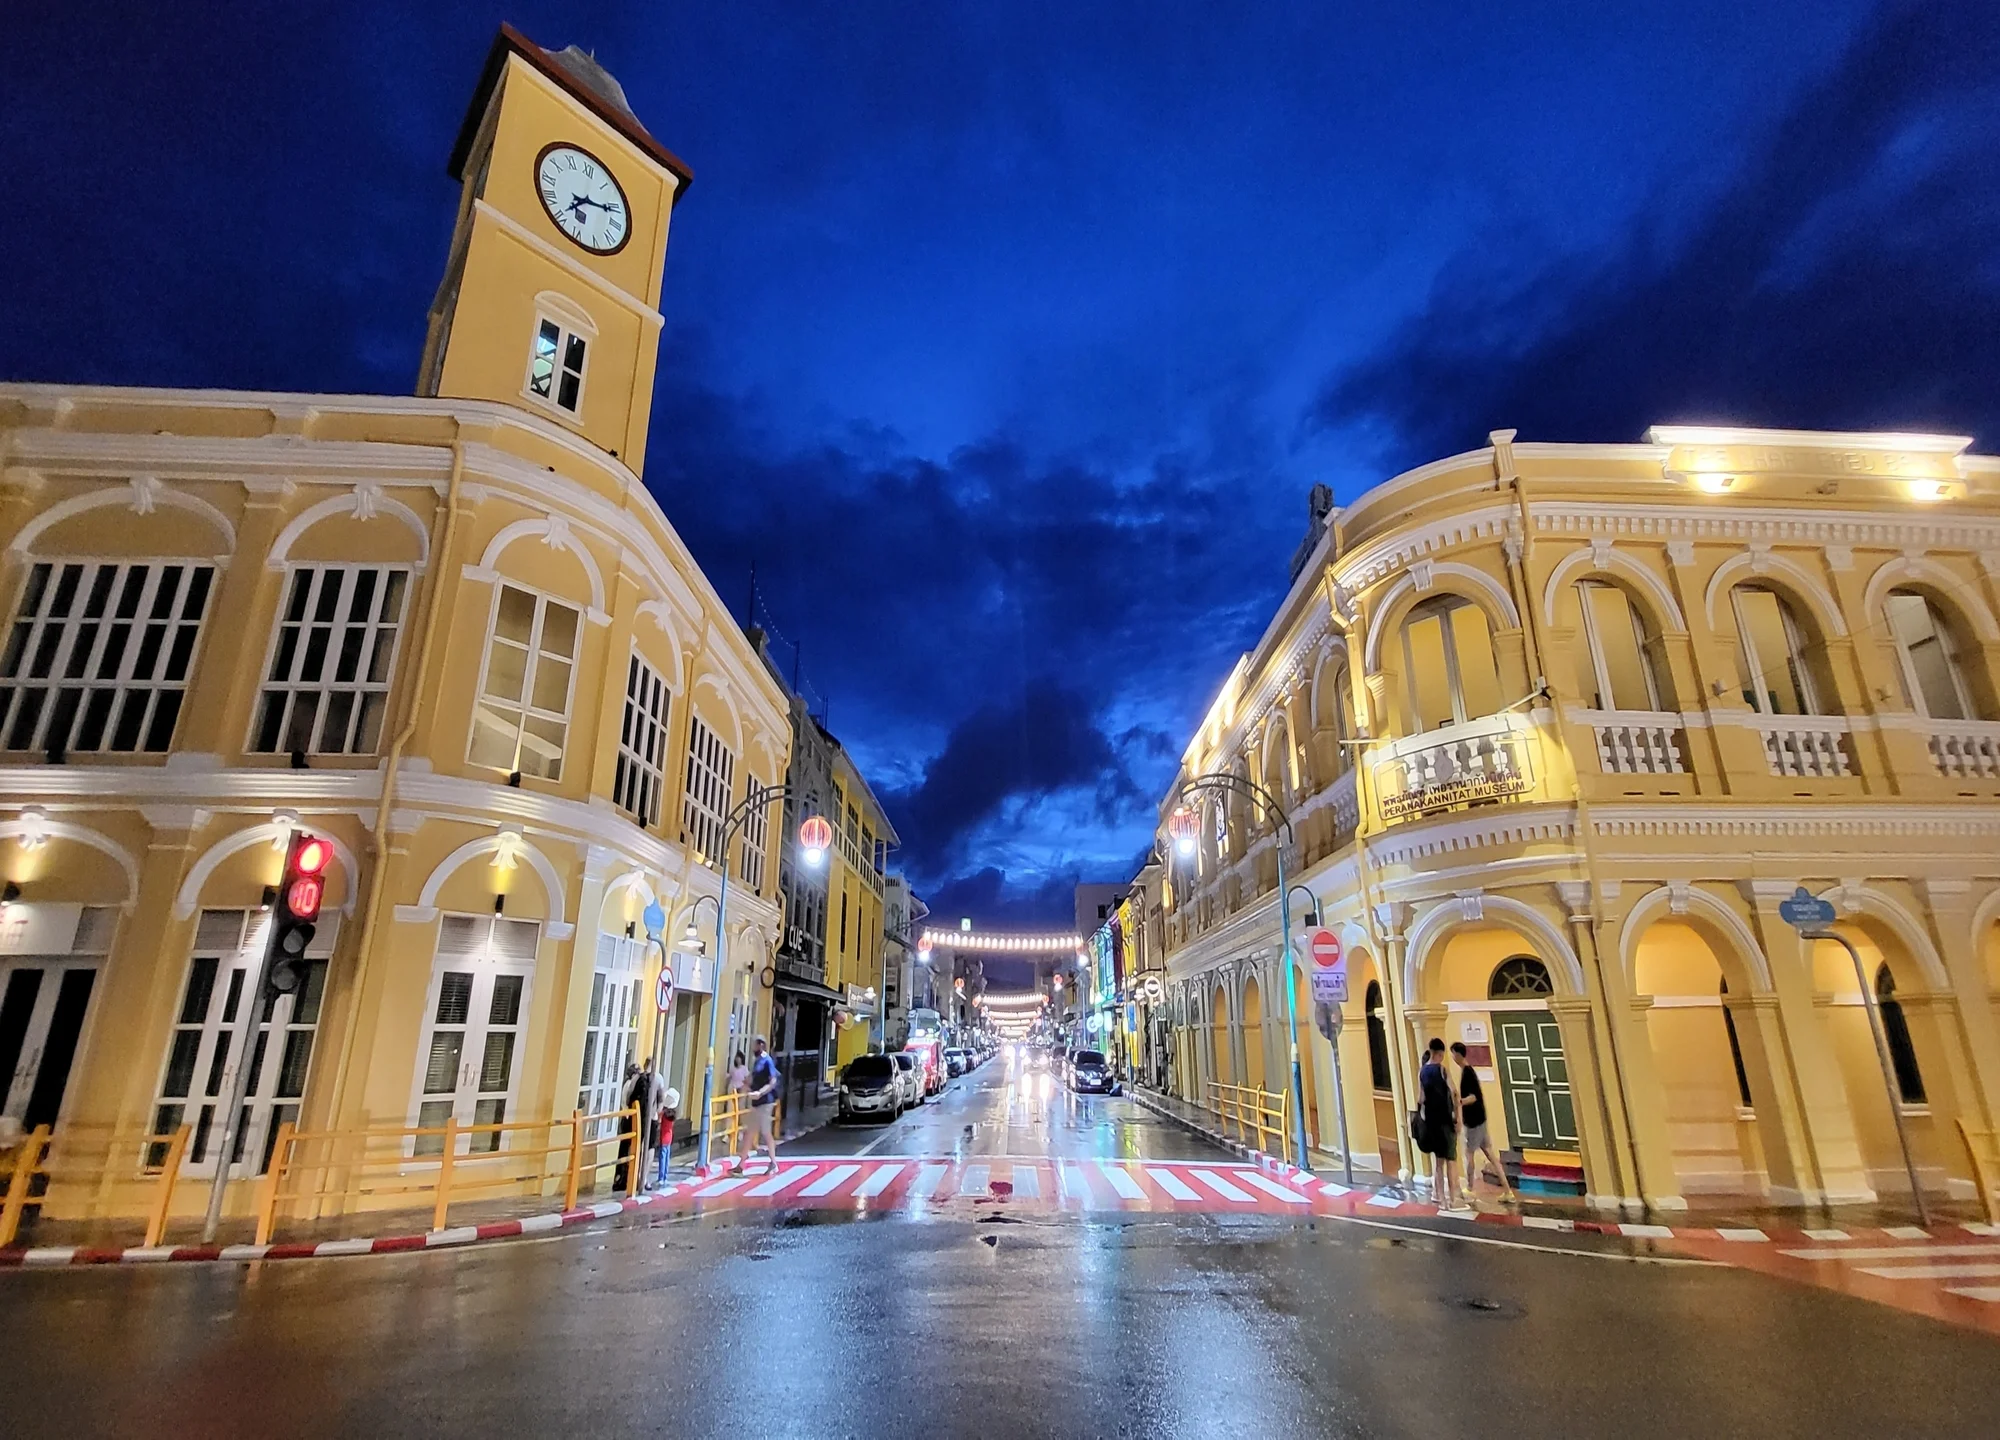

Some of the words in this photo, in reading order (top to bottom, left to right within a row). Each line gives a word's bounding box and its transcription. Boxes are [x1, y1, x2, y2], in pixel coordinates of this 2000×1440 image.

[549, 157, 564, 174] X
[564, 154, 577, 171] XI
[582, 161, 595, 180] XII
[541, 170, 556, 187] IX
[1384, 791, 1472, 818] PERANAKANNITAT
[1475, 780, 1525, 797] MUSEUM
